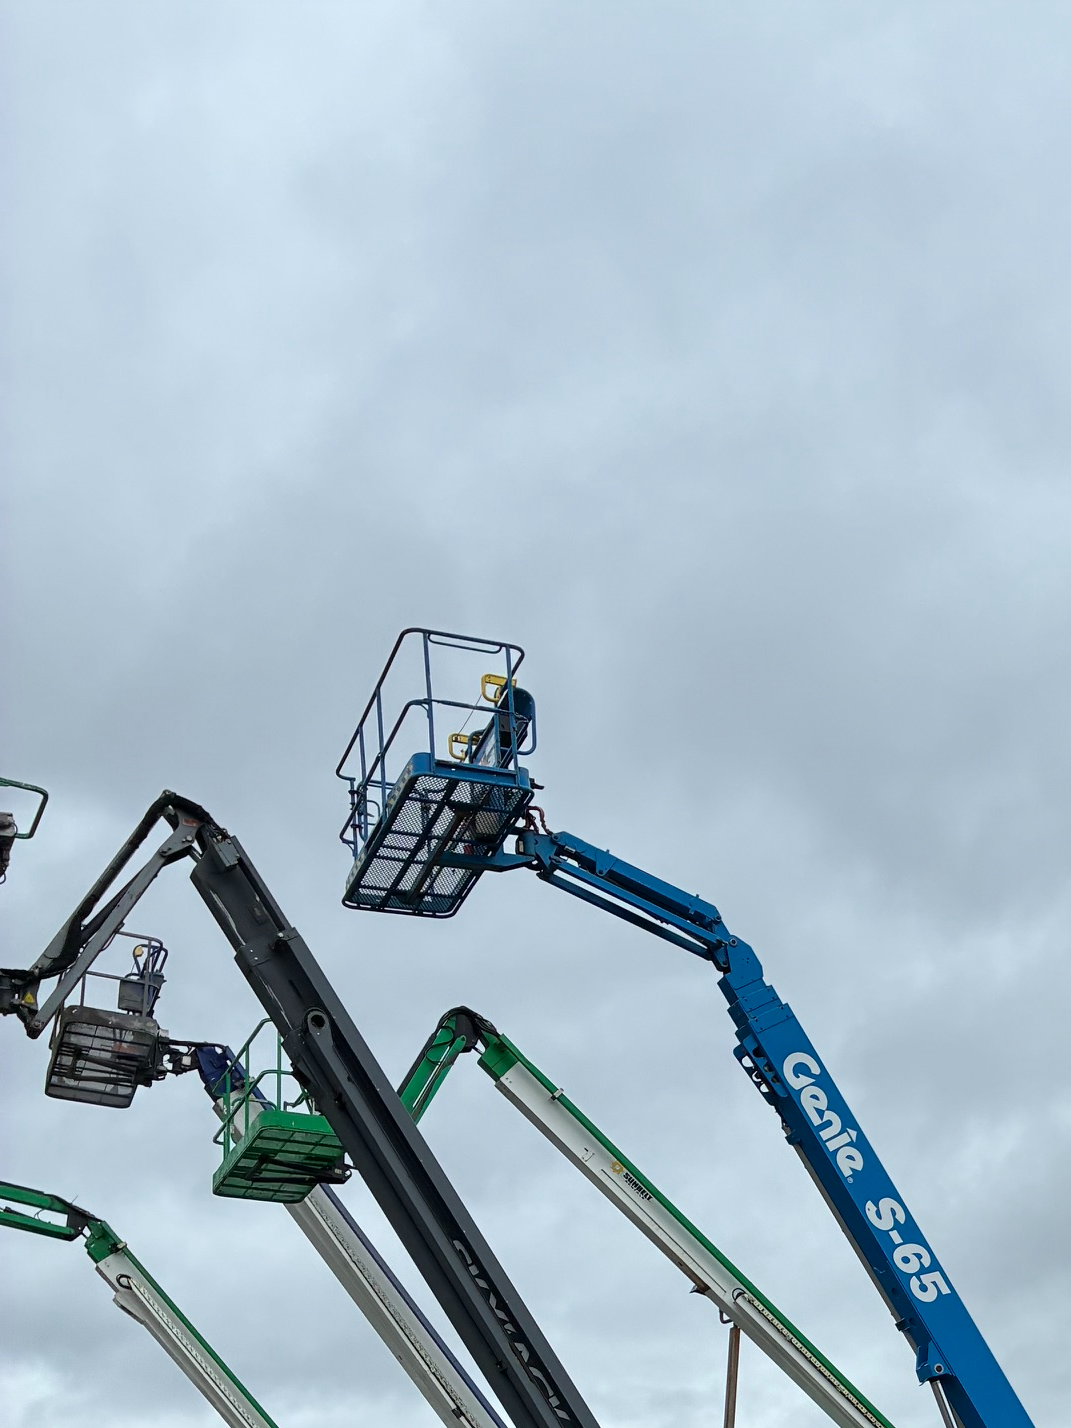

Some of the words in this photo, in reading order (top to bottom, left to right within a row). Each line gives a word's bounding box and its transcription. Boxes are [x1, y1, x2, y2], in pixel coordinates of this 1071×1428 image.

[623, 1172, 653, 1202] SUNBELT
[783, 1052, 864, 1180] Genie
[865, 1197, 951, 1303] S-65
